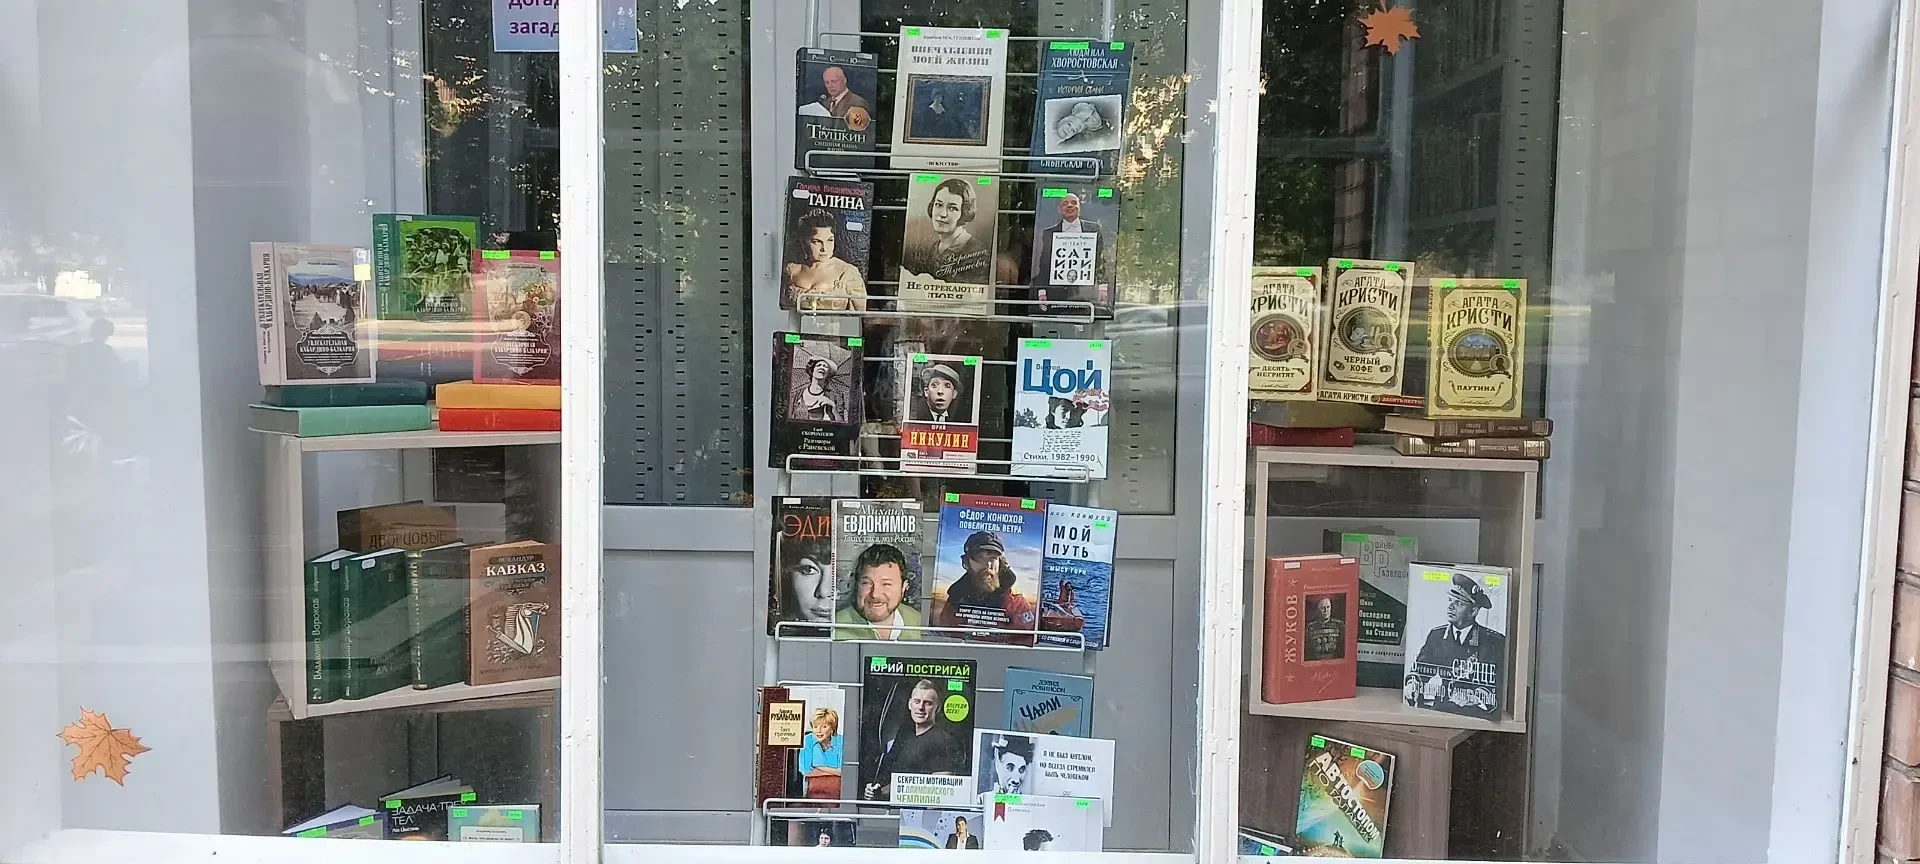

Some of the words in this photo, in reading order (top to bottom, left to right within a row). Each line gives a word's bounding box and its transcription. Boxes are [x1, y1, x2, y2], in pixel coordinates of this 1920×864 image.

[911, 46, 992, 56] ВПЕЧАТЛЕНИЯ
[912, 55, 942, 65] МОЕЙ
[946, 57, 989, 66] ЖИЗНИ
[1051, 57, 1118, 69] ХВОРОСТОВСКАЯ
[807, 123, 866, 143] ТРУШКИН
[1055, 248, 1092, 259] САТ
[923, 284, 985, 294] ОТРЕКАЮТСЯ
[1354, 275, 1387, 289] АГАТА
[1263, 283, 1296, 296] АГАТА
[1338, 287, 1399, 312] КРИСТИ
[1462, 295, 1500, 310] АГАТА
[1446, 306, 1514, 332] КРИСТИ
[1344, 354, 1381, 366] ЧЕРНЫЙ
[1256, 371, 1295, 379] НЕГРИТЯТ
[1261, 365, 1291, 373] ДЕСЯТЬ
[1350, 364, 1373, 374] КОФЕ
[1022, 358, 1103, 396] Цой
[1456, 384, 1496, 393] ПАУТИНА
[1320, 390, 1342, 400] АГАТА
[1344, 391, 1369, 402] КРИСТИ
[909, 431, 970, 449] НИКУЛИН
[1023, 452, 1049, 461] Стихи.
[959, 509, 986, 522] ФЁДОР
[987, 512, 1026, 525] КОНЮХОВ.
[843, 514, 917, 536] ЕВДОКИМОВ
[959, 520, 1001, 533] ПОВЕЛИТЕЛЬ
[1002, 523, 1023, 534] ВЕТРА
[369, 530, 446, 549] ДВОРЦОВЫЕ
[1053, 524, 1091, 543] МОЙ
[1051, 543, 1089, 558] ПУТЬ
[486, 562, 546, 577] КАВКАЗ
[1358, 609, 1391, 620] Последнее
[1284, 594, 1299, 664] ЖУКОВ
[1362, 620, 1395, 630] покушение
[1365, 628, 1373, 636] на
[1374, 628, 1399, 638] Сталина
[311, 637, 323, 680] Владимир
[870, 661, 904, 675] ЮРИЙ
[906, 663, 971, 677] ПОСТРИГАЙ
[1452, 657, 1497, 685] СЕРДЦЕ
[312, 687, 323, 700] 2
[1020, 695, 1062, 721] ЧАРЛИ
[1309, 760, 1330, 787] ПО
[896, 784, 905, 793] ОТ
[897, 775, 925, 785] СЕКРЕТЫ
[926, 777, 964, 788] МОТИВАЦИИ
[1315, 752, 1380, 841] АВТОСТОПОМ
[391, 802, 438, 816] ЗАДАЧА
[392, 815, 414, 827] ТЕЛ
